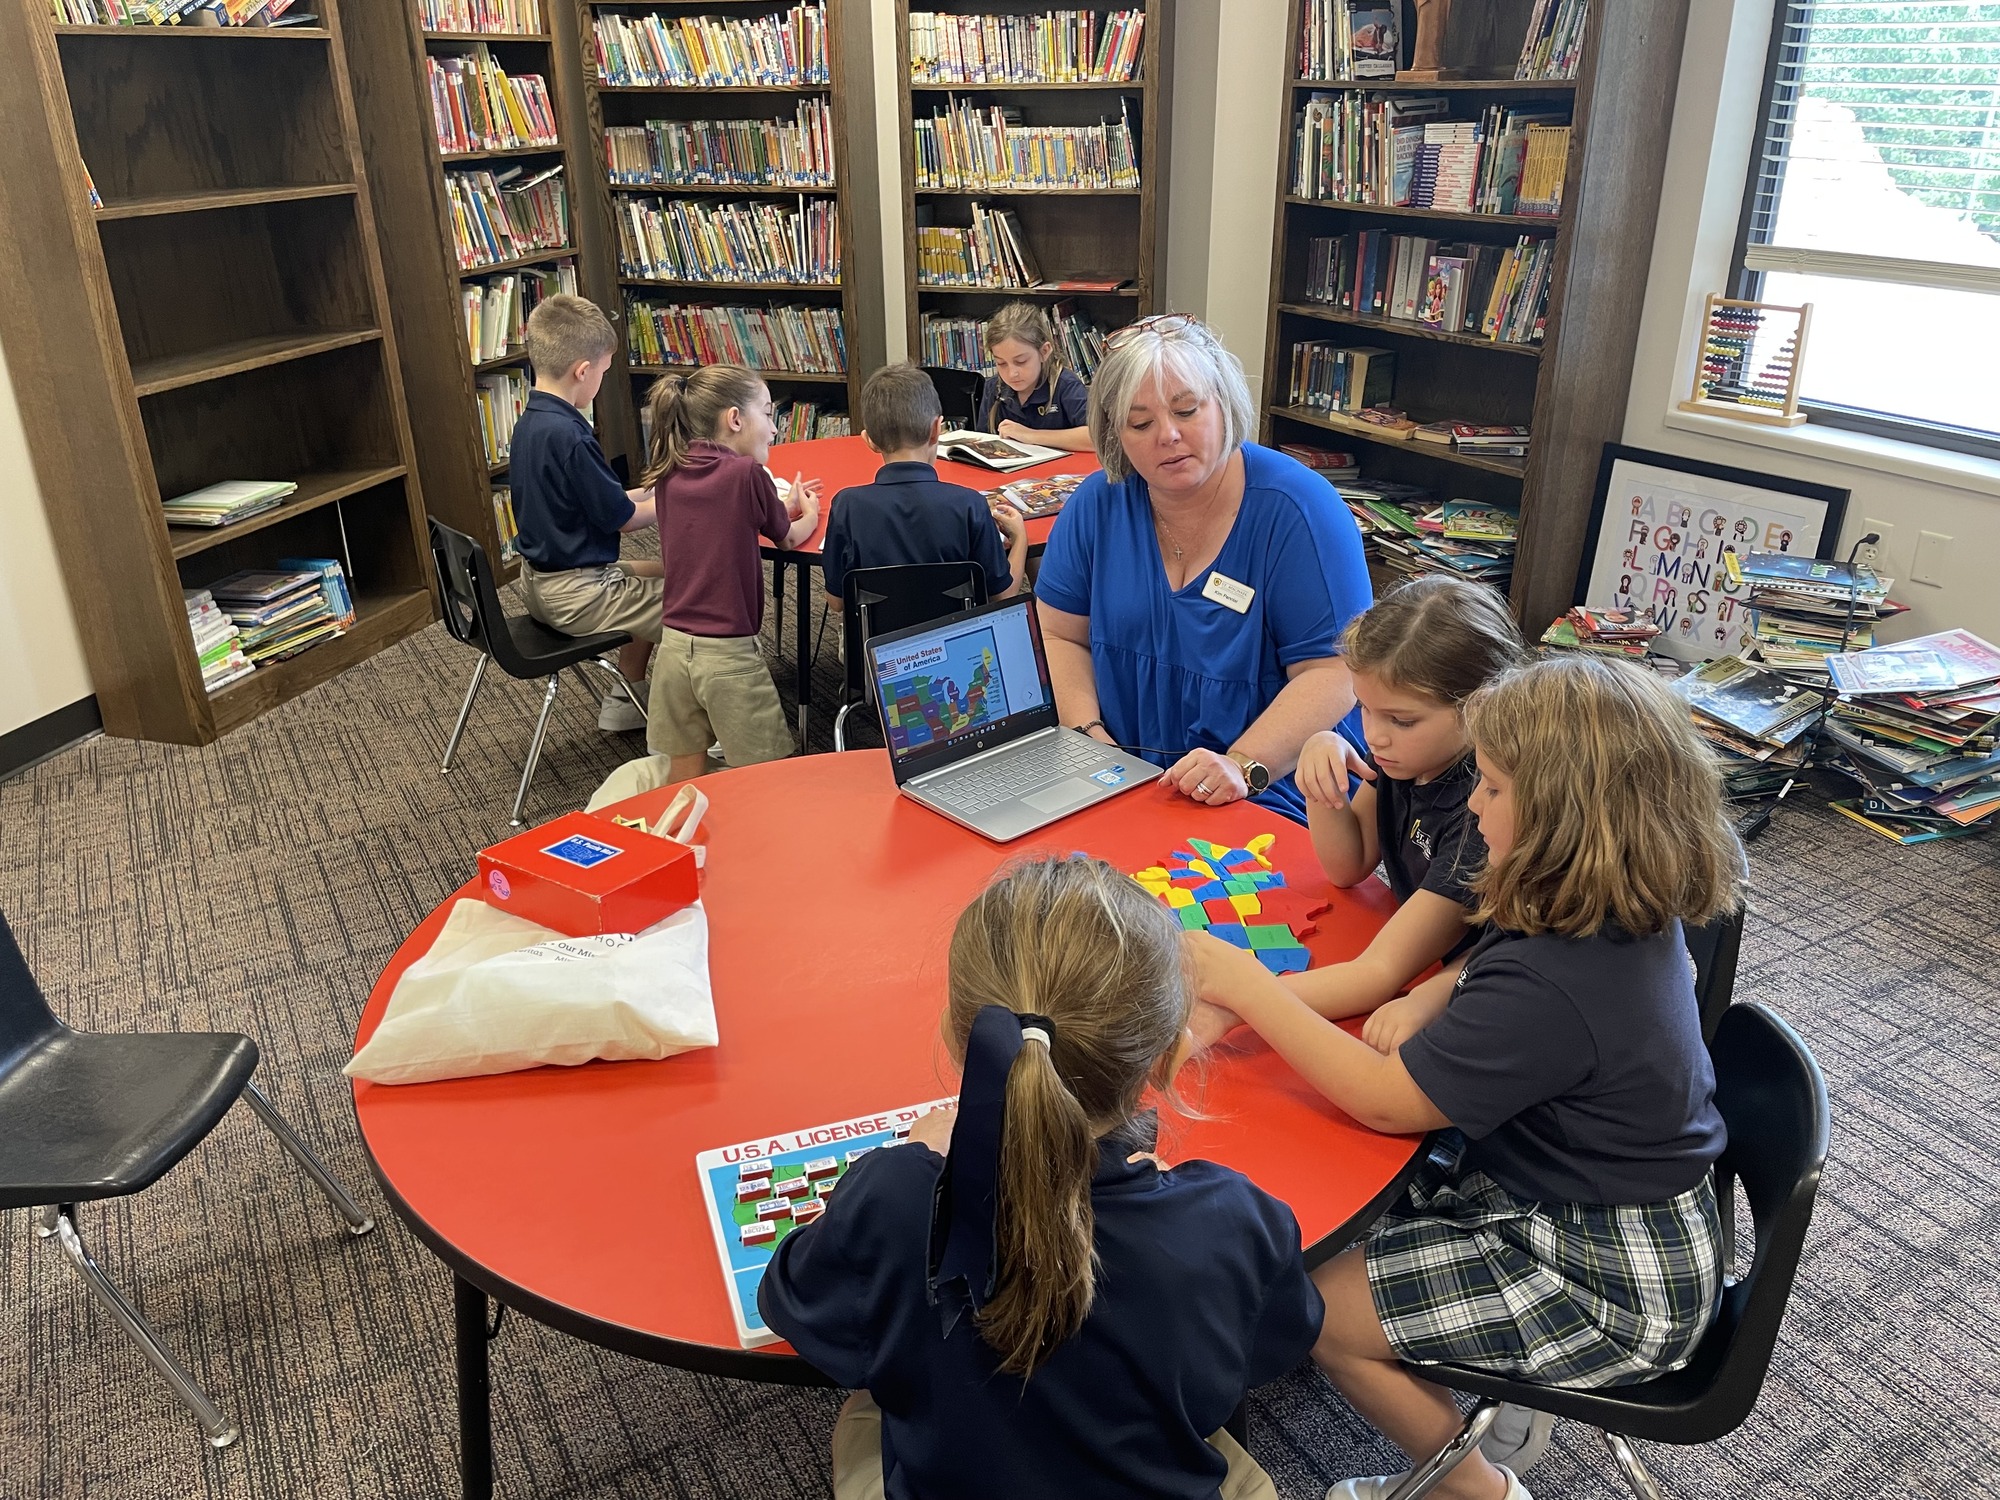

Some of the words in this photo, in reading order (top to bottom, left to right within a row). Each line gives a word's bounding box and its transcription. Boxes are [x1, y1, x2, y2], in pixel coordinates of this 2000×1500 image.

[1629, 519, 1646, 542] F
[1653, 526, 1673, 551] G
[1638, 496, 1656, 522] A
[1666, 500, 1684, 527] B
[1699, 509, 1719, 535] C
[1764, 522, 1784, 550] E
[1631, 545, 1644, 571] L
[1657, 552, 1682, 580] M
[1690, 560, 1711, 588] N
[1630, 573, 1648, 602] Q
[1653, 578, 1671, 605] R
[1696, 590, 1711, 614] S
[1724, 596, 1741, 622] T
[1653, 604, 1678, 632] W
[1687, 615, 1705, 642] X
[896, 652, 919, 665] United
[921, 647, 942, 658] States
[903, 663, 911, 671] of
[912, 655, 940, 669] America
[558, 942, 577, 952] Our
[722, 1140, 790, 1164] U.S.A.
[795, 1117, 891, 1148] LICENSE
